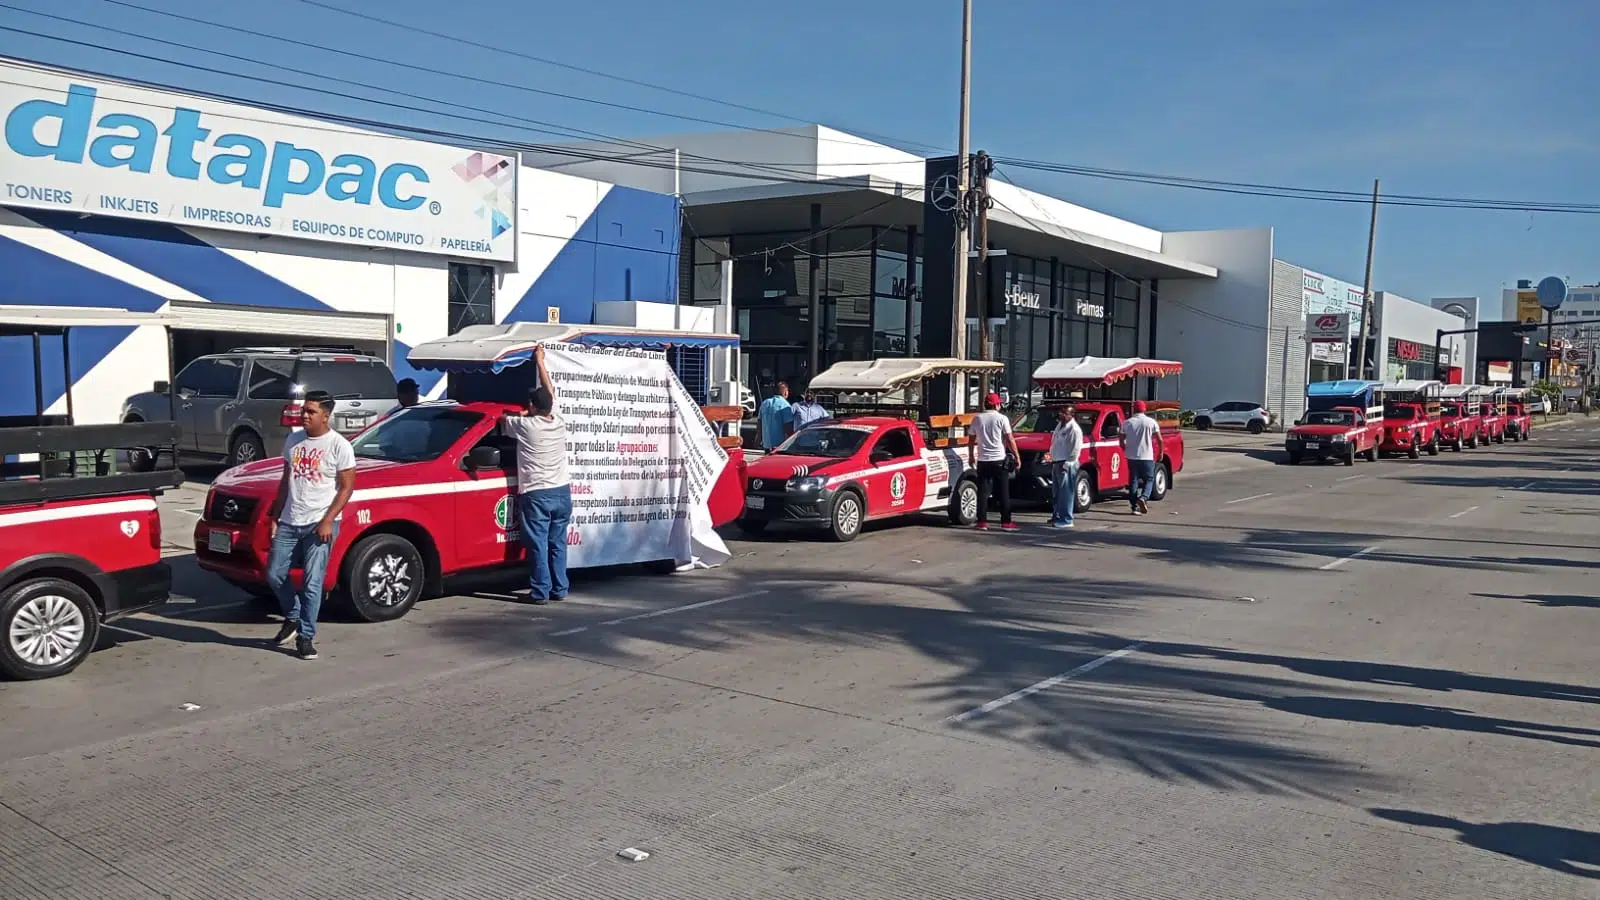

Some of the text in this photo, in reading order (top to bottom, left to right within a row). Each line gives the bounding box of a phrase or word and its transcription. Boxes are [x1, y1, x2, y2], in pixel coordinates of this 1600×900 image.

[4, 84, 431, 211] datapac
[6, 183, 492, 253] TONERS INKJETS IMPRESORAS EQUIPOS DE COMPUTO PAPELERÍA
[1076, 299, 1104, 318] Palmas
[568, 343, 613, 356] Gobernador
[613, 347, 624, 357] del
[625, 348, 647, 359] Estado
[648, 352, 665, 361] Libre
[1396, 340, 1421, 360] NISSAN
[551, 370, 593, 383] agrupaciones
[593, 372, 603, 384] del
[603, 373, 629, 388] Municipio
[629, 375, 637, 386] de
[557, 387, 591, 401] Transporte
[591, 389, 613, 401] Público
[613, 393, 617, 403] y
[637, 392, 645, 402] las
[571, 404, 606, 418] infringiendo
[607, 406, 613, 417] la
[613, 407, 622, 419] Ley
[622, 407, 629, 418] de
[629, 408, 658, 421] Transporte
[690, 400, 706, 426] Estado
[704, 425, 712, 436] de
[590, 421, 602, 436] tipo
[602, 421, 620, 433] Safari
[620, 423, 645, 437] pasando
[645, 426, 657, 438] por
[574, 441, 588, 455] por
[588, 440, 605, 452] todas
[606, 440, 616, 452] las
[575, 457, 594, 466] hemos
[595, 456, 622, 466] notificado
[657, 457, 663, 465] de
[586, 470, 593, 480] si
[593, 470, 620, 480] estuviera
[620, 470, 640, 480] dentro
[578, 499, 608, 509] respetuoso
[608, 496, 631, 507] llamado
[635, 498, 643, 506] su
[357, 509, 372, 524] 102
[576, 515, 587, 528] que
[619, 511, 637, 522] buena
[638, 511, 656, 524] imagen
[657, 509, 669, 520] del
[127, 522, 134, 535] 5
